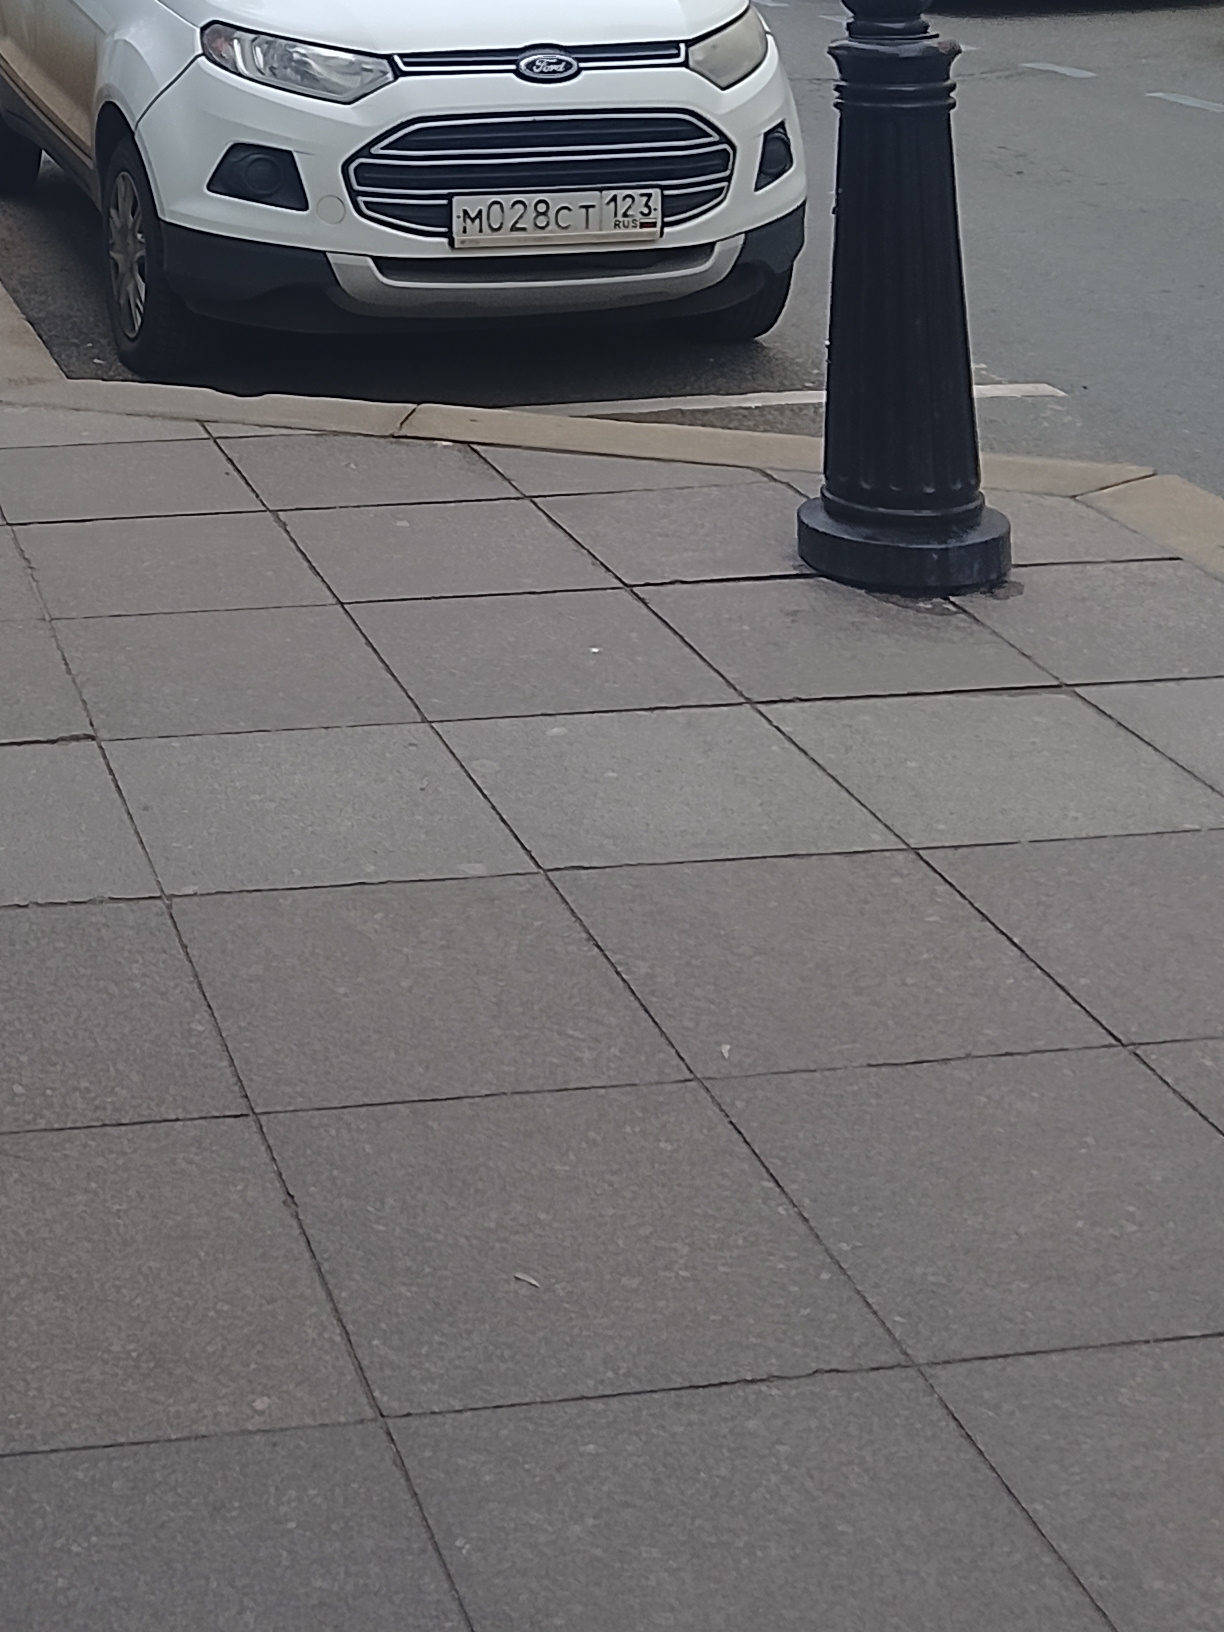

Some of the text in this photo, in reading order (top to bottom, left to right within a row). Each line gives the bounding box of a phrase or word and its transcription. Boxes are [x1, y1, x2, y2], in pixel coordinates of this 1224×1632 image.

[532, 58, 567, 73] Ford
[462, 192, 653, 235] М028СТ 123
[613, 218, 638, 230] RUS
